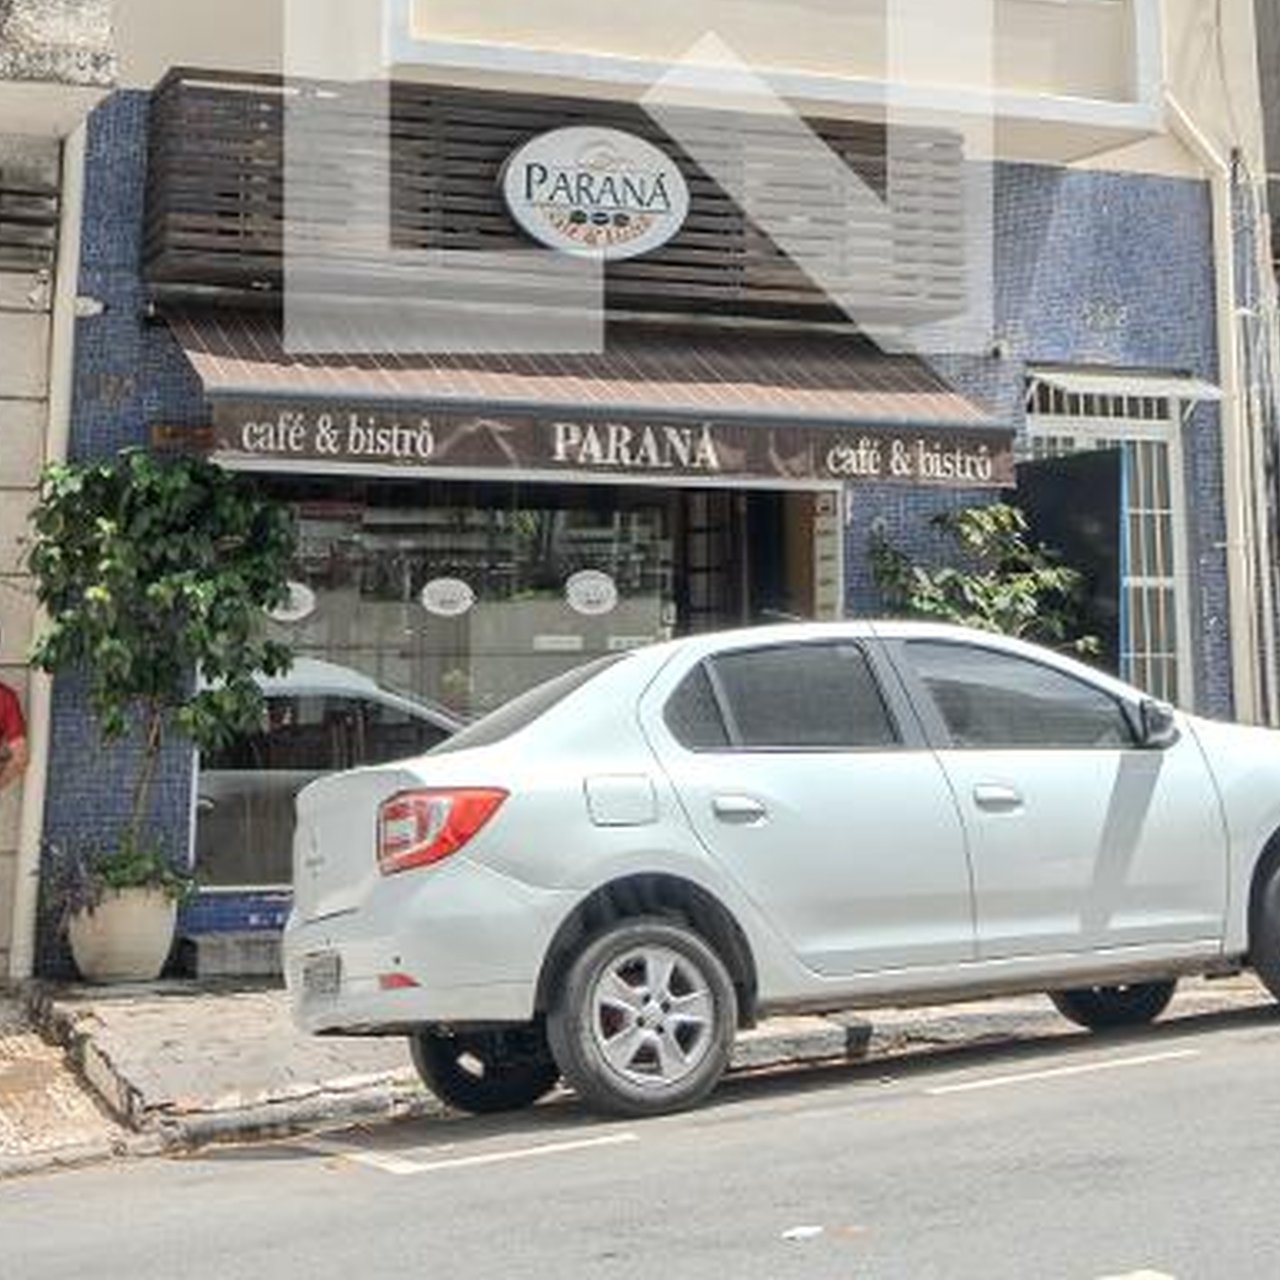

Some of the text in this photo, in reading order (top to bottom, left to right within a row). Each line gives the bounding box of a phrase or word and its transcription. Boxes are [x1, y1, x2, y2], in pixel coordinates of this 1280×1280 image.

[524, 162, 671, 209] PARANÁ
[242, 412, 434, 457] café & bistrô
[552, 421, 720, 470] PARANÁ
[826, 436, 882, 475] café
[889, 438, 912, 477] &
